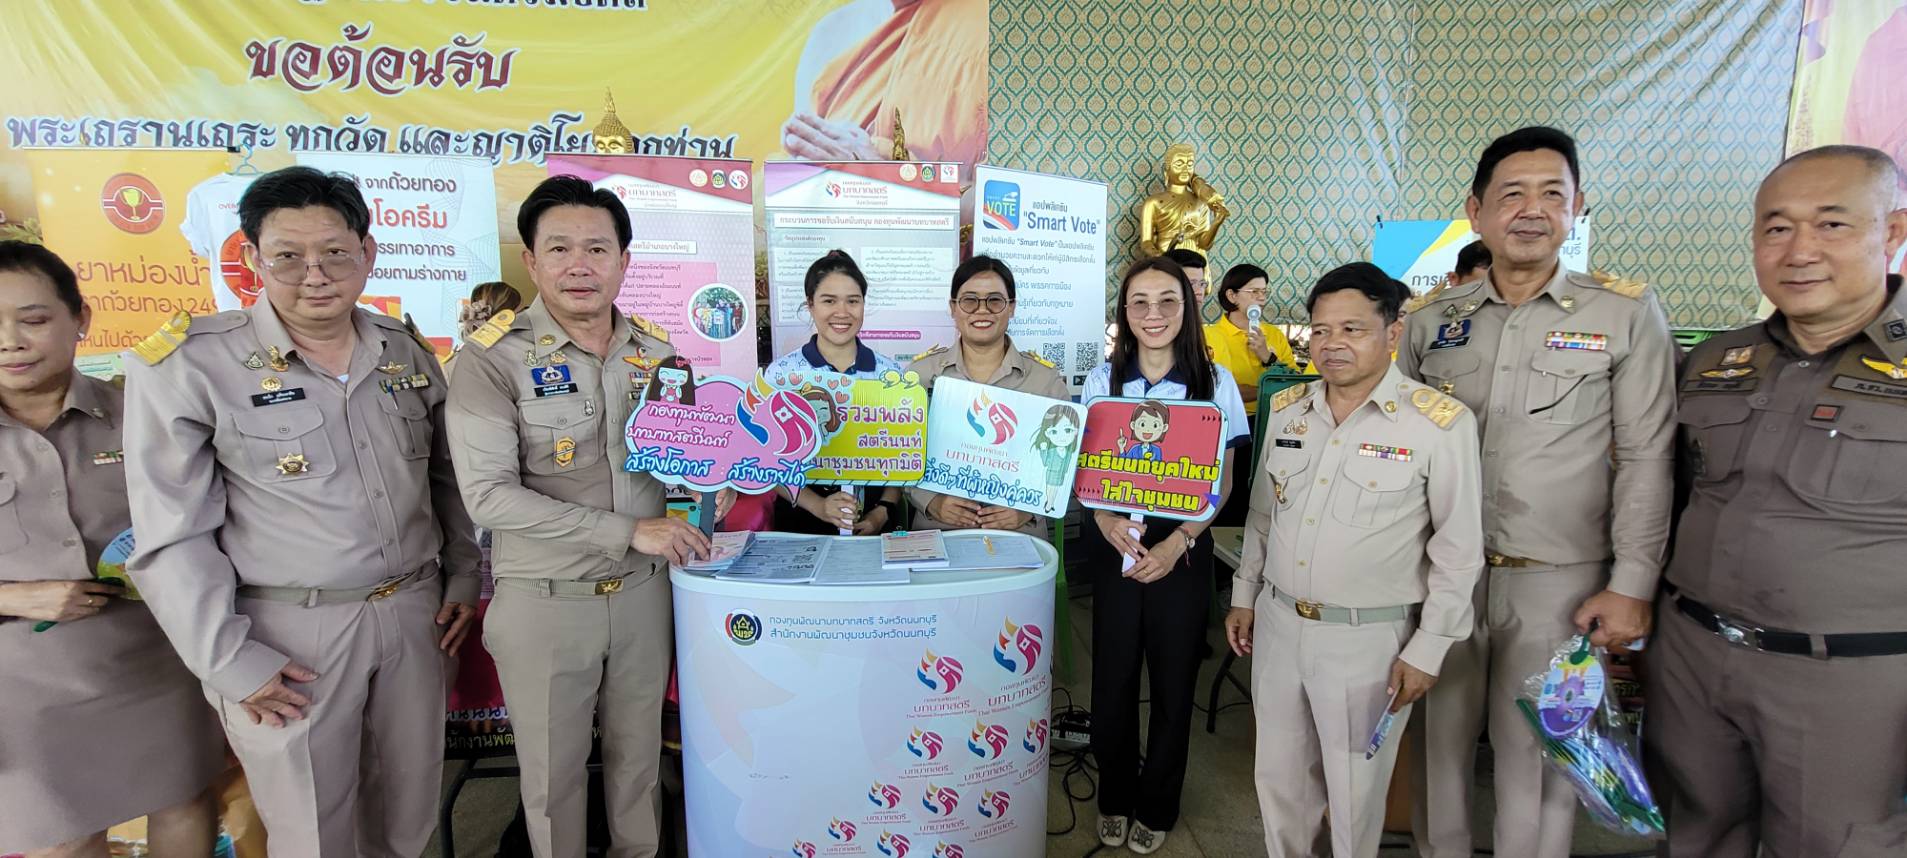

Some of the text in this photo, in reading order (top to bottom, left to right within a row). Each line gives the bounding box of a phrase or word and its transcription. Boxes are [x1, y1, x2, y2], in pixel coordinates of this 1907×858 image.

[246, 23, 517, 94] ขอต้อนรับ
[365, 171, 457, 193] จากถ้วยทอง
[986, 200, 1016, 217] VOTE
[1023, 211, 1067, 231] "Smart
[836, 398, 925, 423] รวมพลัง
[857, 430, 923, 448] สตรีนนท์
[624, 446, 816, 487] สร้างโอกาส สร้างรายได้
[945, 449, 1020, 473] บทบาทสตรี
[1077, 449, 1221, 482] สตรีนนท์ยุคใหม่
[769, 614, 936, 627] กองทุนพัฒนาบทบาทสตรี จังหวัดนนทบุรี
[770, 627, 936, 642] สำนักงานพัฒนาชุมชนจังหวัดนนทบุรี
[988, 675, 1047, 706] บทบาทสตรี
[913, 699, 970, 713] บทบาทสตรี
